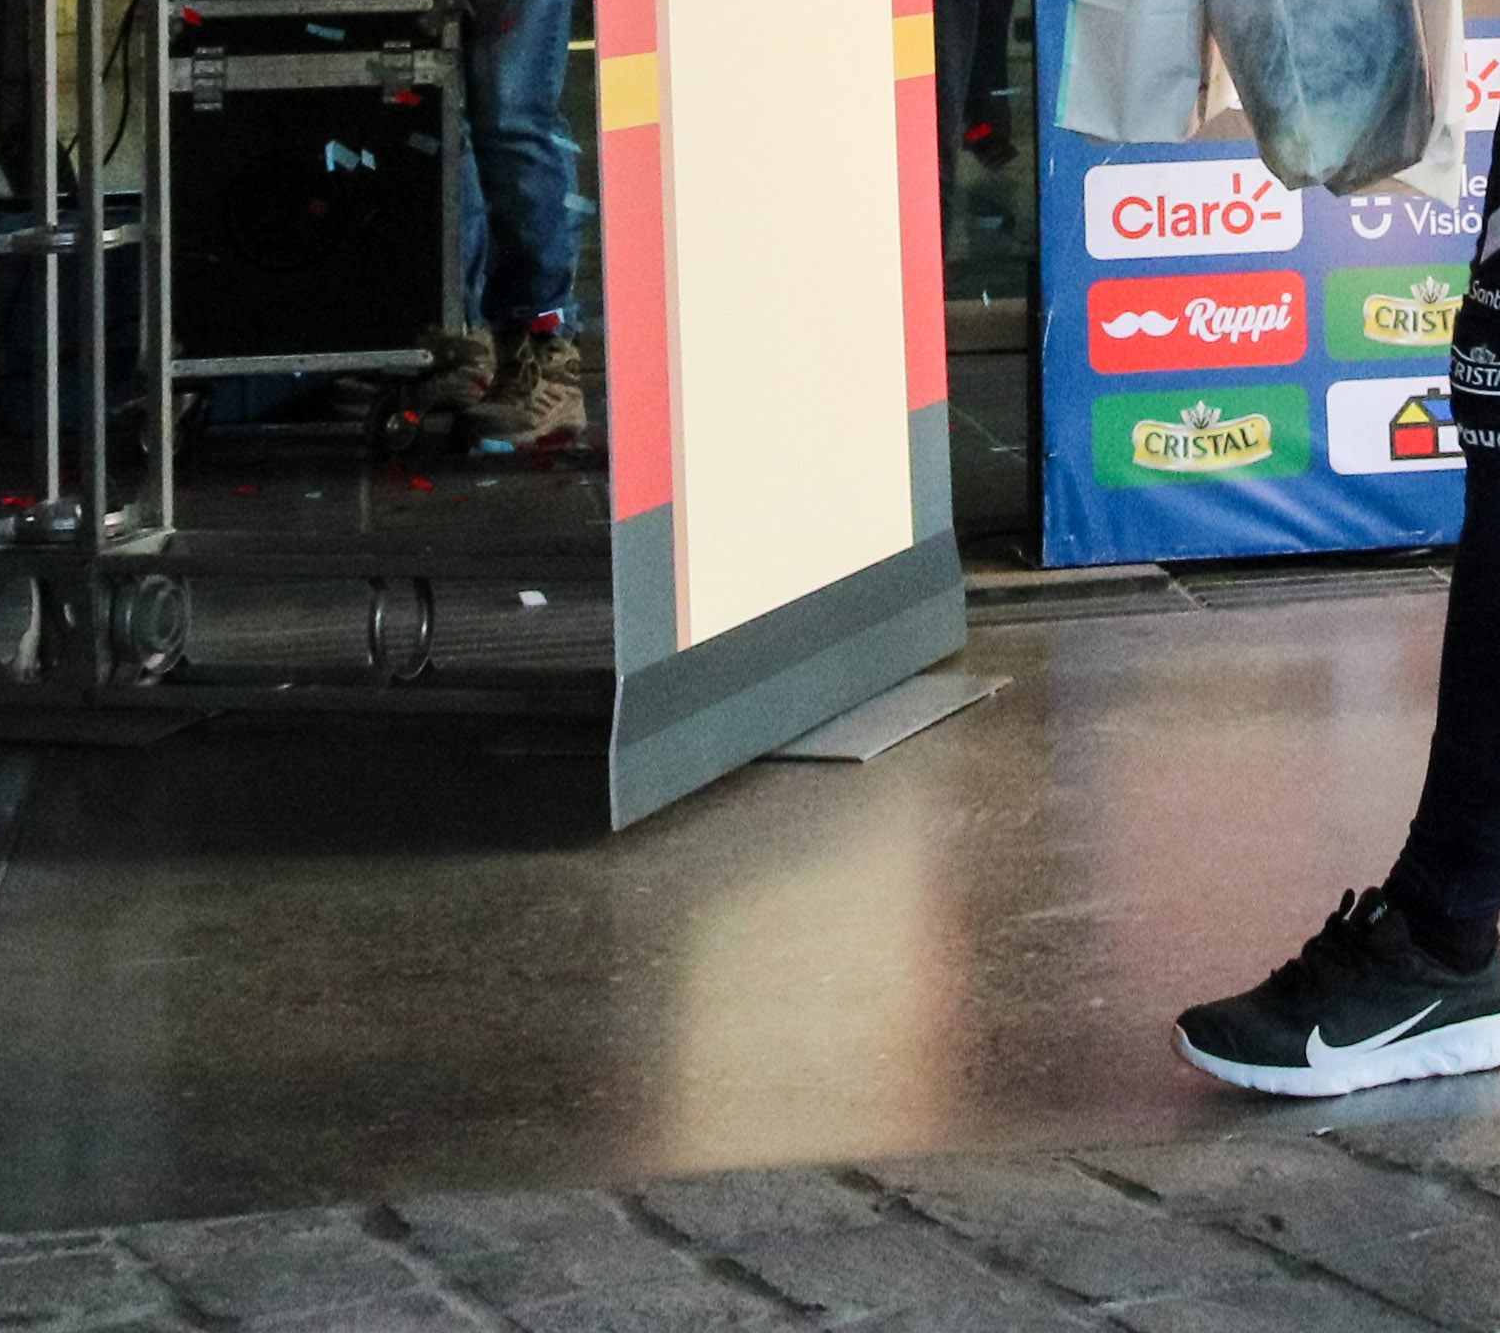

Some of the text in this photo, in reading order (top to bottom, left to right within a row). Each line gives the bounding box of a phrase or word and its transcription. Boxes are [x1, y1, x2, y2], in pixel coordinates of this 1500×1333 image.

[1112, 191, 1254, 240] Claro
[1405, 200, 1484, 236] Visió
[1185, 292, 1294, 345] Rappi
[1374, 306, 1462, 332] CRIST
[1144, 426, 1258, 461] CRISTAL
